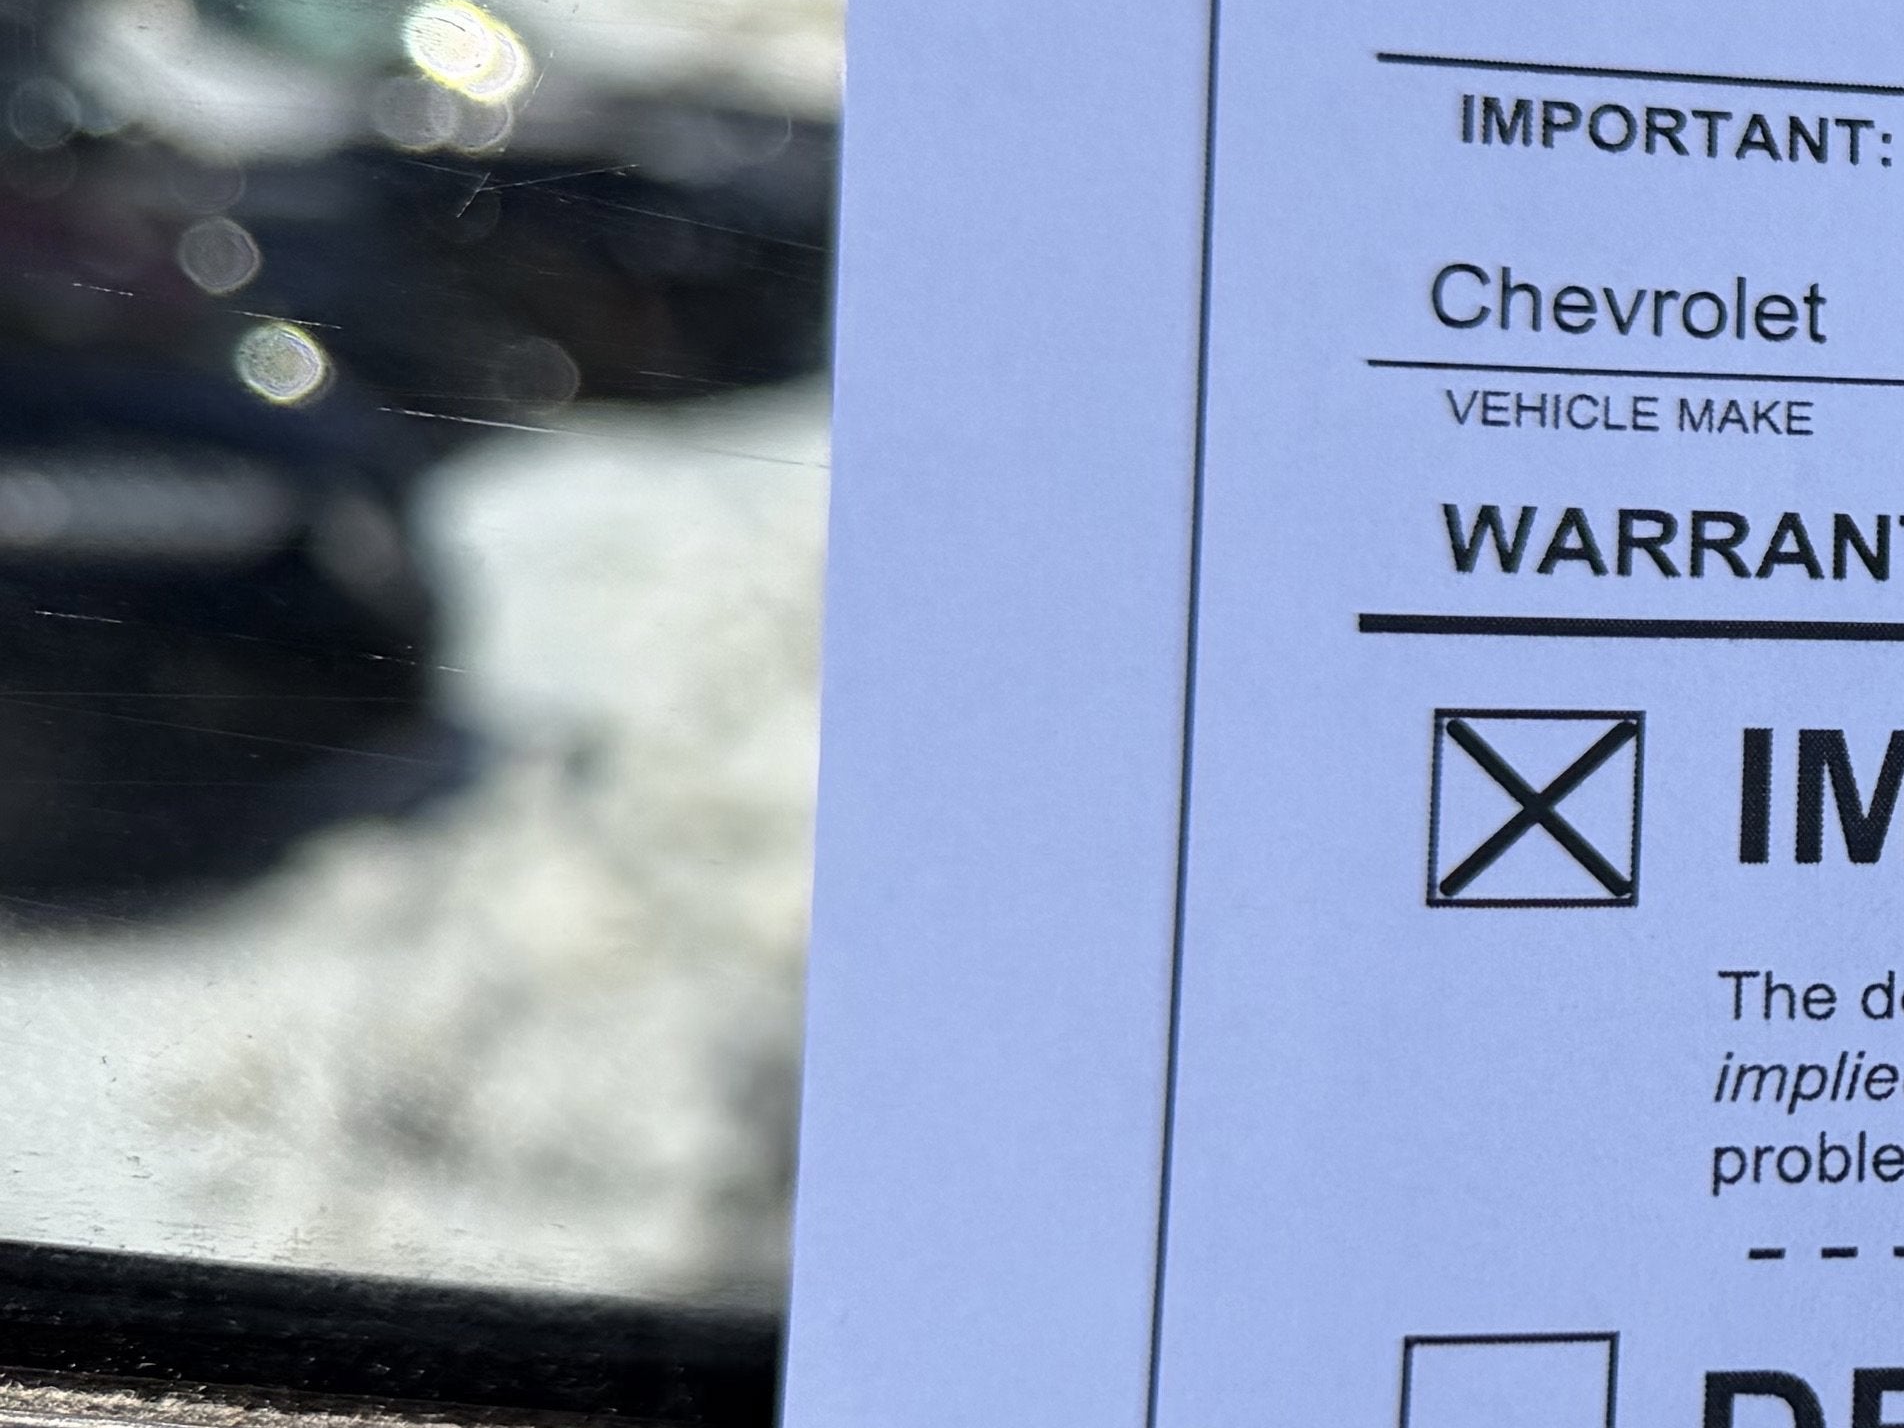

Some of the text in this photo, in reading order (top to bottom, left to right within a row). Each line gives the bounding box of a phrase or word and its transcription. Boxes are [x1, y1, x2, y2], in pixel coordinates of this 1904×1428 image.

[1461, 94, 1892, 168] IMPORTANT:
[1430, 263, 1827, 344] Chevrolet
[1445, 389, 1814, 436] VEHICLE MAKE
[1717, 970, 1837, 1021] The
